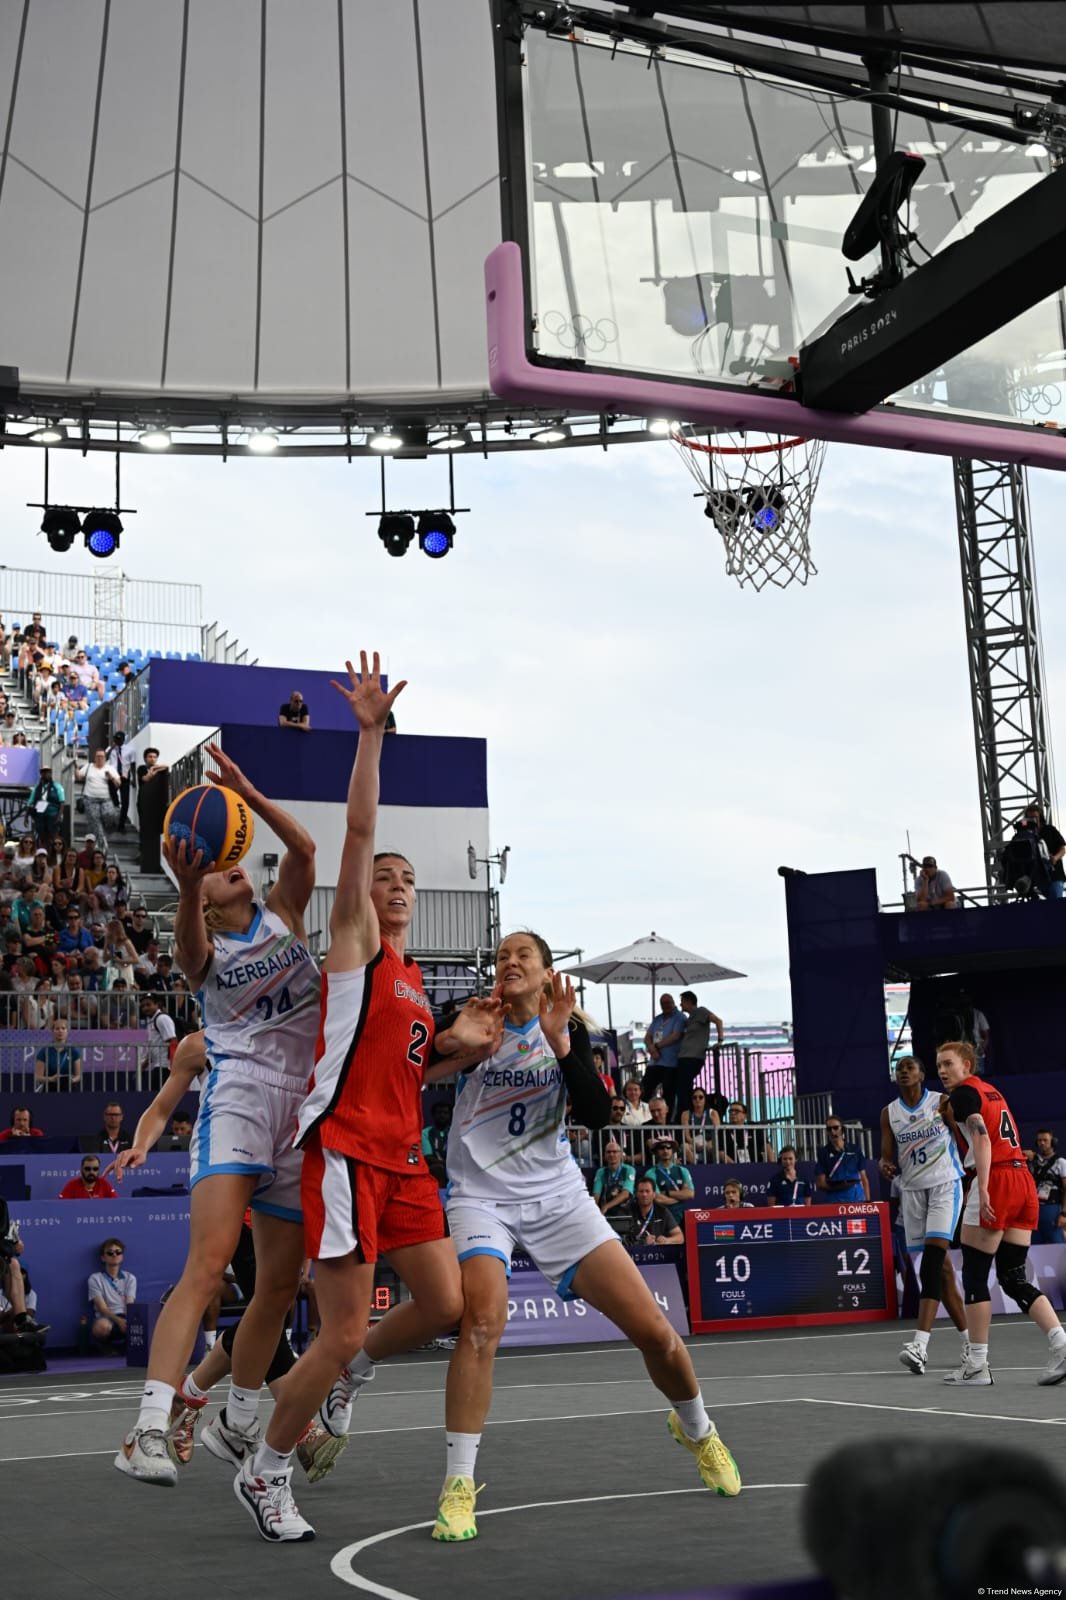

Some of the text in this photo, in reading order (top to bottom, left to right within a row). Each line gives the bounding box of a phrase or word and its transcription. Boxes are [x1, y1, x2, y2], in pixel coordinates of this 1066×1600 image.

[841, 310, 897, 354] PARIS 2024
[225, 803, 247, 861] Wilson
[215, 943, 310, 991] AZERBAIJAN
[256, 986, 294, 1021] 24
[407, 1020, 429, 1067] 2
[24, 1046, 104, 1062] PIS
[508, 1102, 527, 1137] 8
[999, 1109, 1019, 1149] 4
[910, 1147, 928, 1166] 15
[149, 1213, 191, 1222] PARIS 20
[848, 1205, 879, 1214] OMEGA
[77, 1216, 104, 1224] PARIS
[806, 1220, 842, 1237] CAN
[740, 1223, 774, 1240] AZE
[511, 1260, 530, 1268] 024
[715, 1255, 750, 1282] 10
[837, 1249, 870, 1276] 12
[721, 1290, 745, 1298] FOULS
[843, 1283, 866, 1291] FOULS
[507, 1298, 587, 1320] PARIS
[730, 1303, 739, 1314] 4
[852, 1296, 859, 1307] 3
